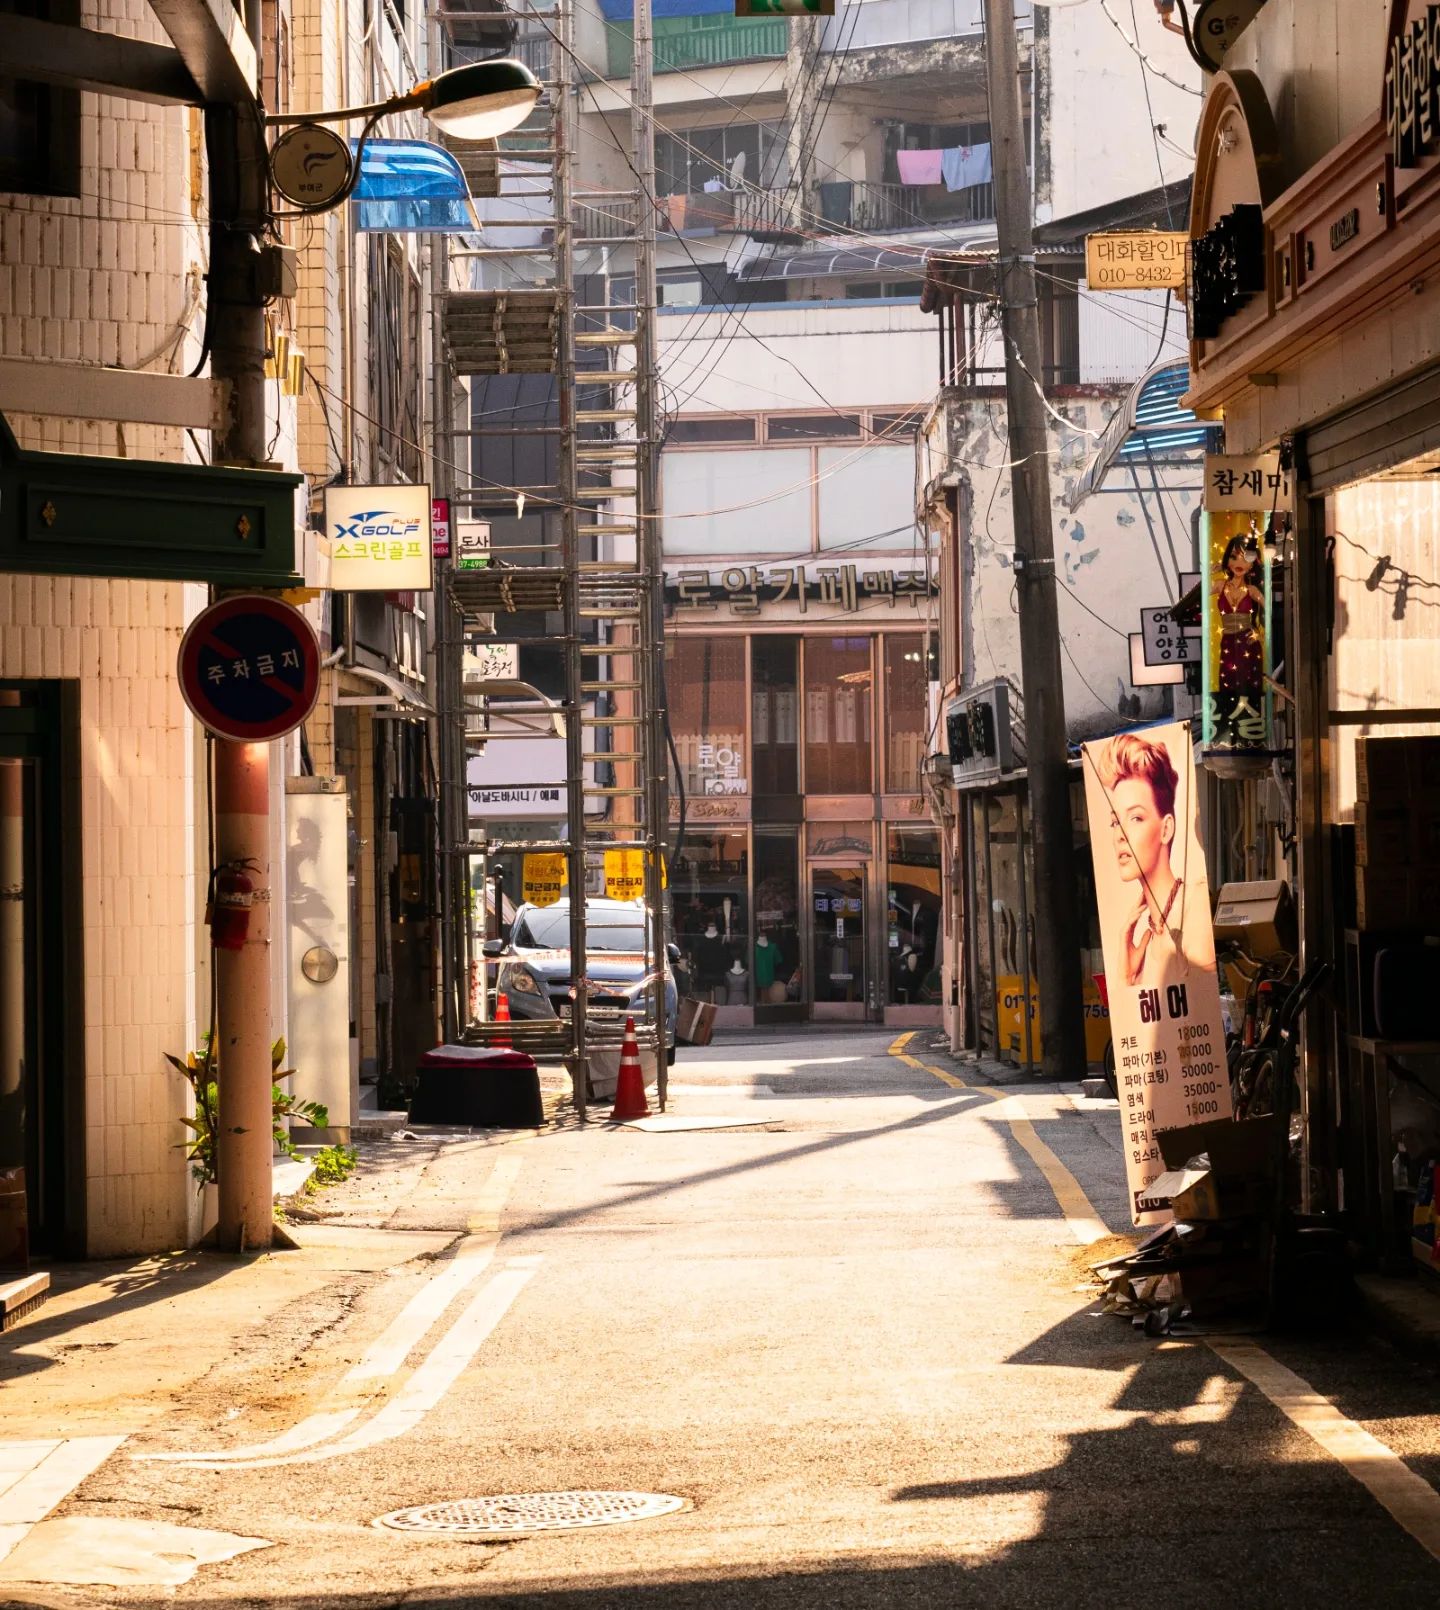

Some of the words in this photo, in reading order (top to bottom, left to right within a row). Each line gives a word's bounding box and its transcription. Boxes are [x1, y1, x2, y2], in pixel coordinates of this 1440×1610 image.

[1099, 267, 1185, 283] 010-8432-
[334, 541, 423, 560] 스크린골프
[675, 564, 858, 616] 로얄카페
[862, 569, 940, 608] 맥주
[208, 649, 300, 685] 주차금지
[698, 744, 742, 778] 로얄
[1121, 1036, 1138, 1050] 커트
[1122, 1049, 1167, 1069] 파마(기본)
[1127, 1092, 1144, 1107] 염색
[1129, 1109, 1155, 1125] 드라이
[1130, 1130, 1149, 1144] 매직
[1133, 1148, 1160, 1164] 업스타
